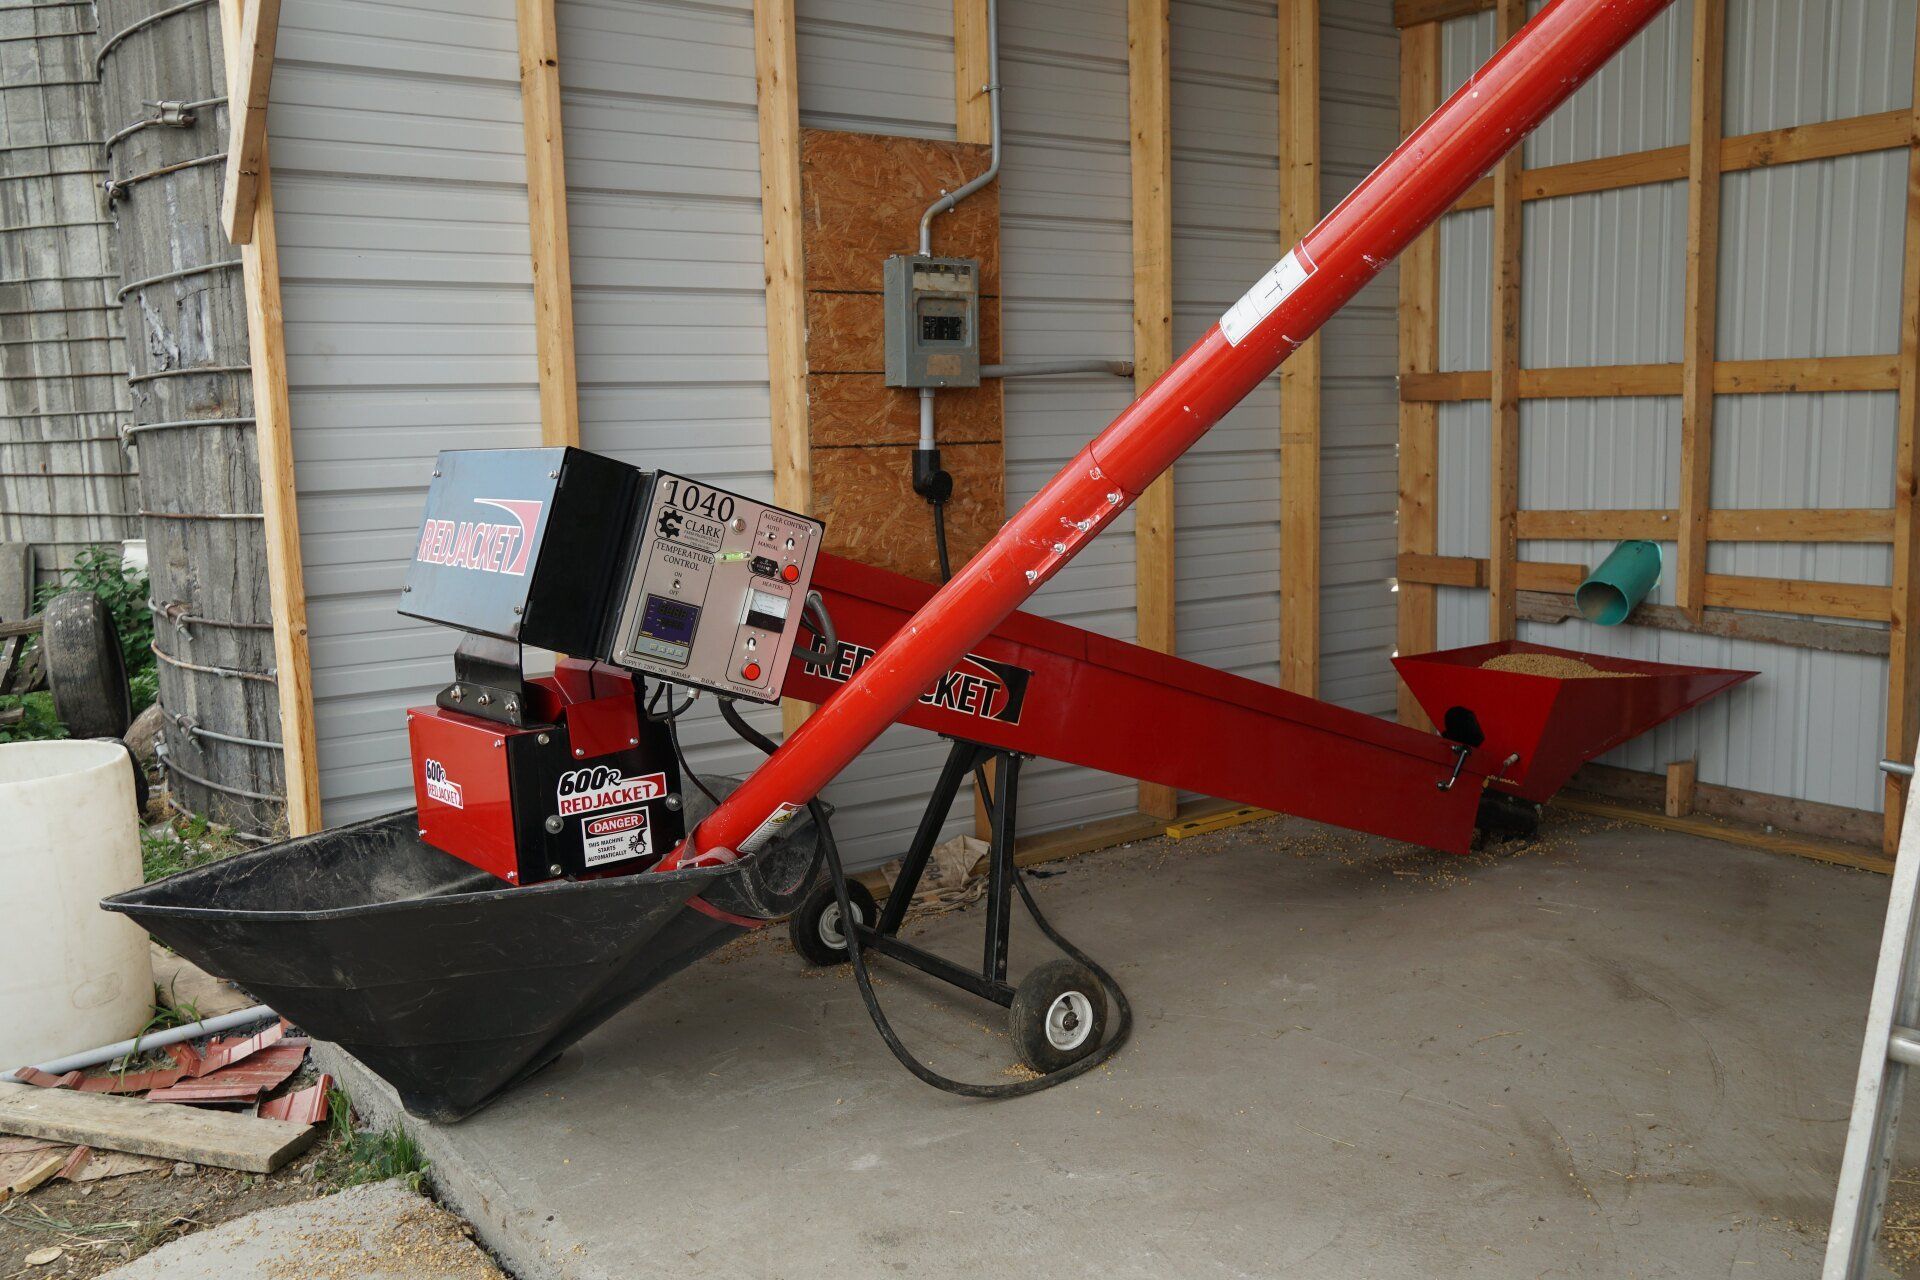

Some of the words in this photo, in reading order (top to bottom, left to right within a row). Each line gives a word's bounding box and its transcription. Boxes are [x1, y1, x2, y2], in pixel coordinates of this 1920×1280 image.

[664, 480, 735, 522] 1040
[685, 519, 721, 539] CLARK
[763, 513, 783, 526] AUGER
[783, 520, 809, 532] CONTROL
[766, 524, 780, 532] AUTO
[758, 541, 778, 551] MANUAL
[656, 541, 714, 565] TEMPERATURE
[663, 554, 700, 571] CONTROL
[762, 580, 784, 591] HEATERS
[669, 589, 679, 597] OFF
[732, 685, 751, 695] PATENT
[593, 815, 639, 833] DANGER
[588, 841, 600, 849] THIS
[600, 836, 624, 848] MACHINE
[587, 849, 627, 863] AUTOMATICALLY
[597, 845, 616, 854] STARTS
